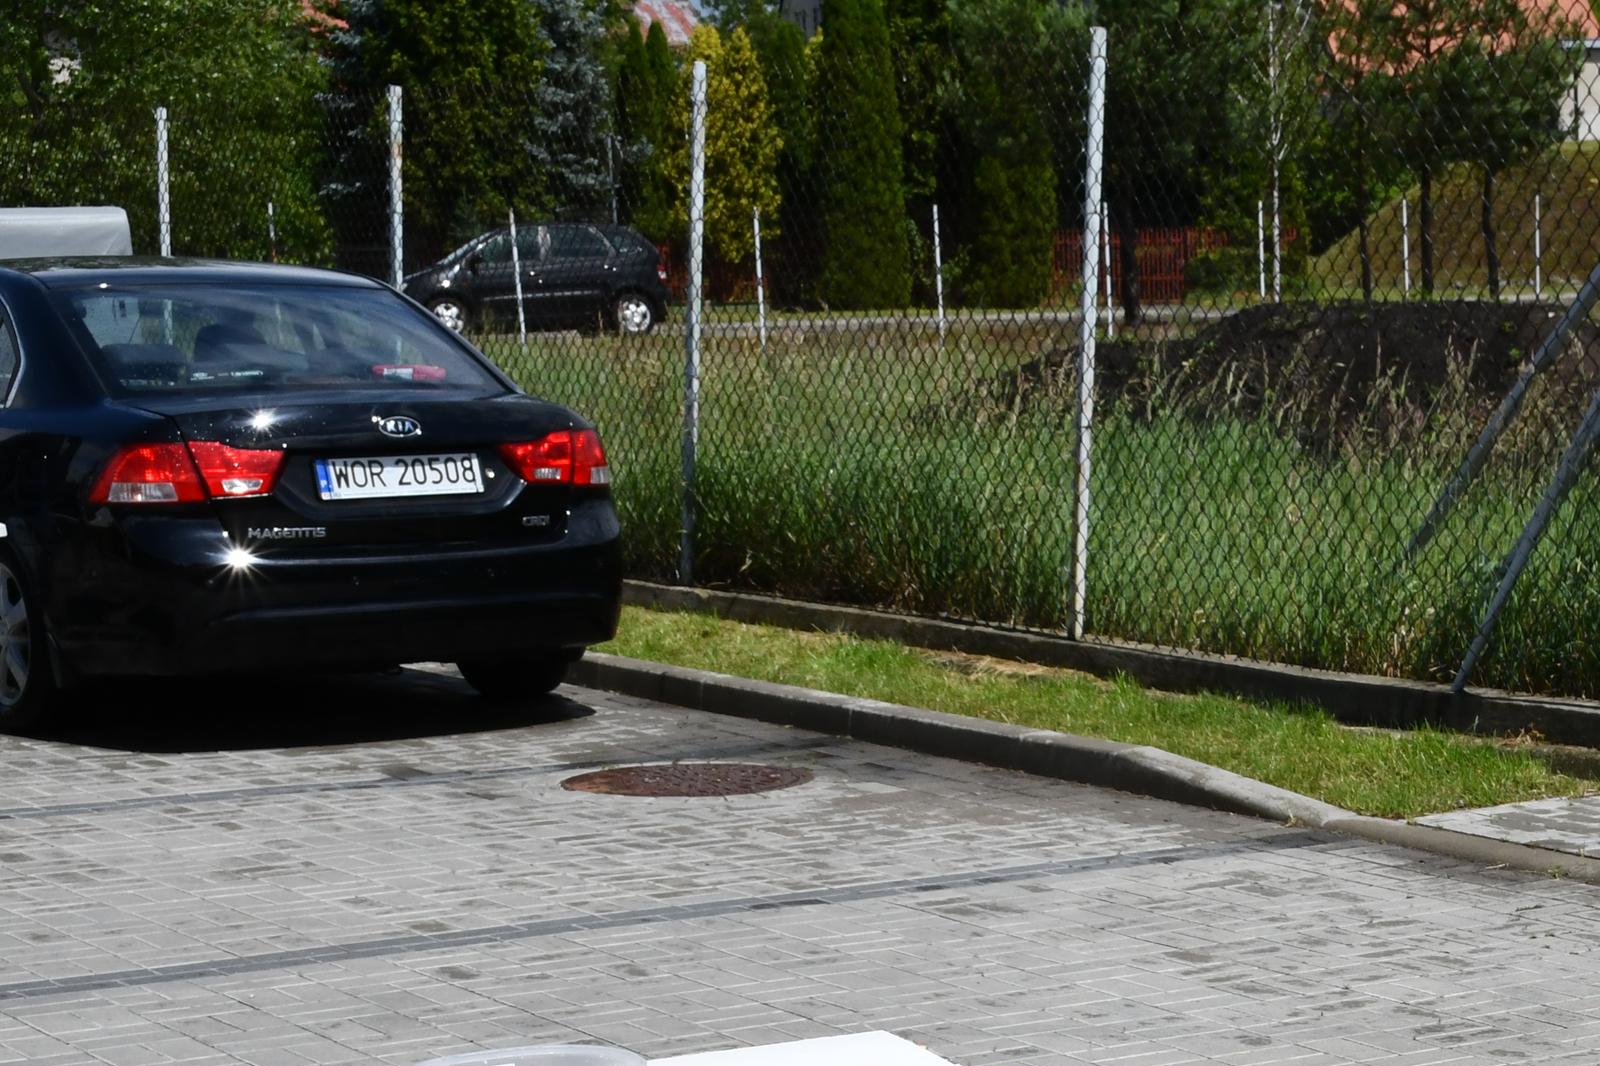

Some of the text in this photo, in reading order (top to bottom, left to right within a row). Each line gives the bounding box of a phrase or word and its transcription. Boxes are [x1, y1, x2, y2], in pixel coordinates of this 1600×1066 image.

[386, 420, 414, 433] KIA
[331, 456, 476, 489] WOR 20508
[247, 526, 327, 539] MAGENTIS
